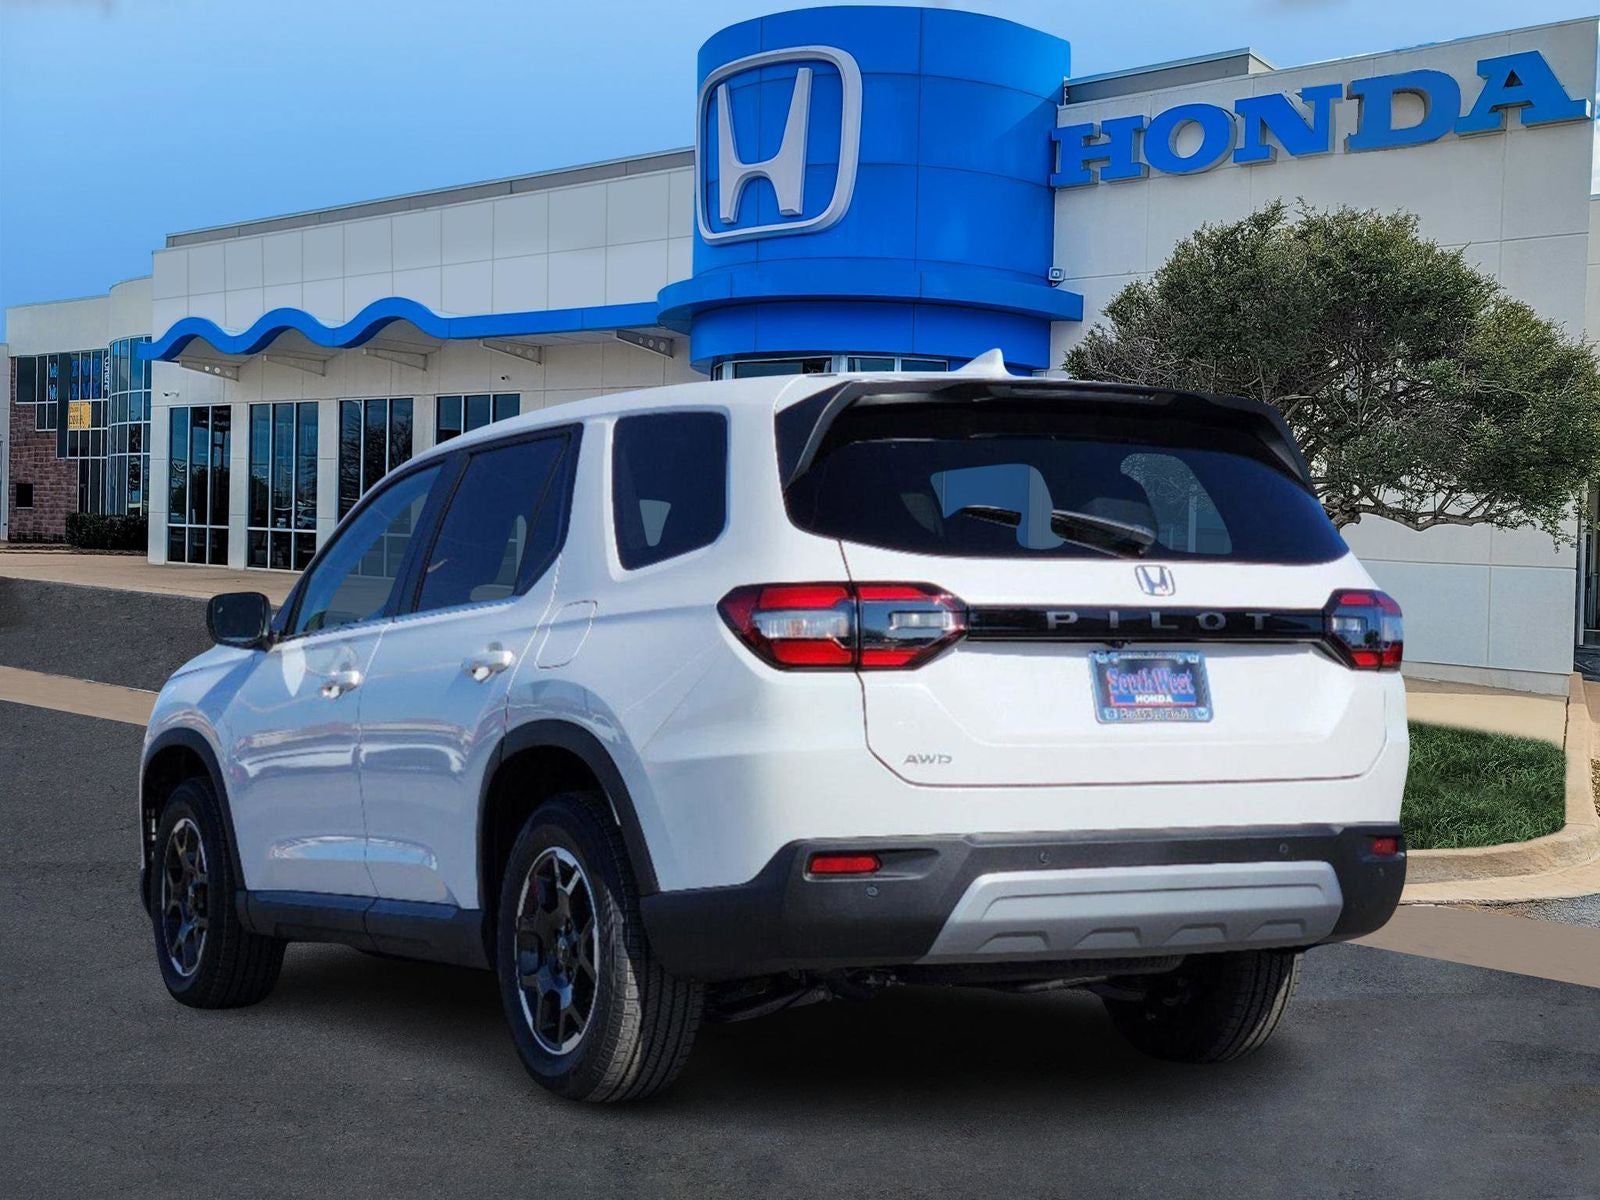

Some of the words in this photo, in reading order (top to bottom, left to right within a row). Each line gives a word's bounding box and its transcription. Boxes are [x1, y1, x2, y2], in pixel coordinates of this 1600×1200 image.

[1050, 50, 1591, 189] HONDA
[1046, 610, 1271, 630] PILOT
[1134, 694, 1174, 703] HONDA
[902, 753, 952, 765] AWD
